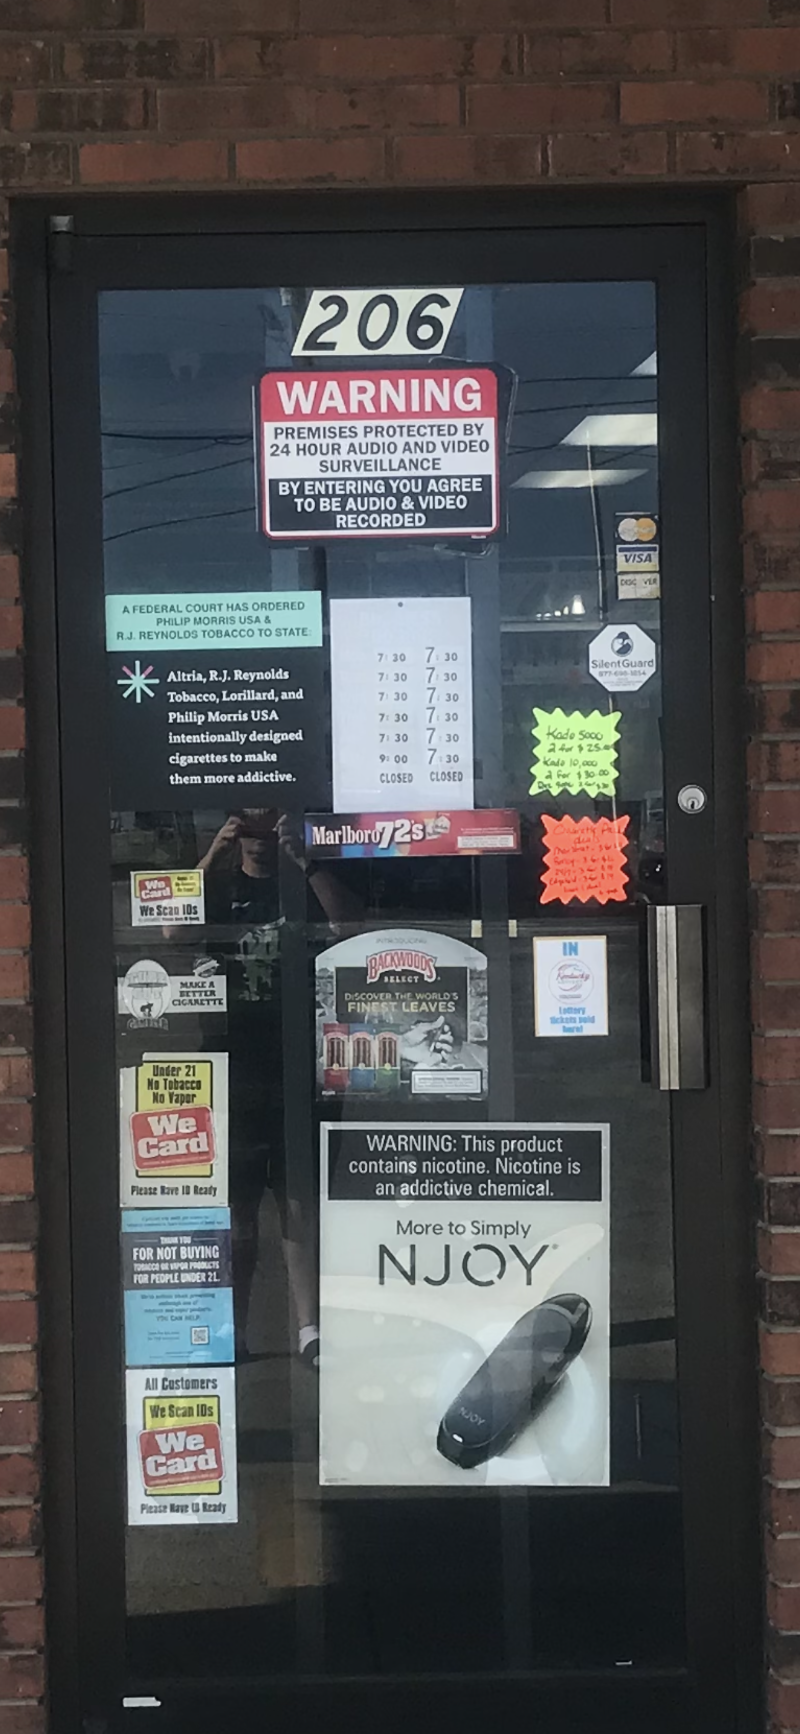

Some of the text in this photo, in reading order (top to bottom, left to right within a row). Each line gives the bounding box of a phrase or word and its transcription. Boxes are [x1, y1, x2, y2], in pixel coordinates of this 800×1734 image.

[302, 294, 451, 350] 206
[276, 378, 482, 415] WARNING
[274, 423, 484, 439] PREMISES PROTECTED BY
[270, 439, 489, 456] 24 HOUR AUDIO AND VIDEO
[319, 458, 441, 473] SURVEILLANCE
[278, 478, 482, 495] BY ENTERING YOU AGREE
[294, 495, 467, 512] TO BE AUDIO & VIDEO
[336, 513, 426, 528] RECORDED
[624, 553, 653, 564] VISA
[620, 578, 658, 587] DISCVER
[122, 601, 305, 614] A FEDERAL COURT HAS ORDERED
[156, 615, 271, 626] PHILIP MORRIS USA &
[116, 627, 312, 641] R.J. REYNOLDS TOBACCO TO STATE:
[167, 669, 289, 683] Altria, R.J. Reynolds
[167, 688, 303, 704] Tobacco, Lorillard, and
[168, 710, 279, 725] Philip Morris USA
[168, 730, 303, 744] intentionally designed
[578, 729, 603, 740] 5000
[547, 742, 556, 753] 2
[558, 743, 574, 753] for
[169, 751, 277, 767] cigarettes to make
[569, 759, 598, 769] 10,000
[169, 771, 297, 784] them more addictive.
[379, 771, 463, 784] CLOSED CLOSED
[544, 770, 553, 780] 2
[556, 769, 571, 779] for
[312, 825, 381, 845] Marlboro
[375, 818, 426, 848] 72's
[144, 880, 166, 889] We
[141, 887, 172, 899] Card
[139, 904, 198, 917] We Scan IDs
[562, 941, 578, 956] IN
[367, 951, 437, 983] BACKWOODS
[179, 981, 207, 989] MAKE
[383, 975, 419, 983] SELECT
[179, 990, 216, 998] BETTER
[344, 992, 459, 1001] DISCOVER THE WORLD'S
[171, 998, 224, 1006] CIGARETTE
[347, 1001, 456, 1013] FINEST LEAVES
[559, 1006, 586, 1015] Lottery
[549, 1016, 577, 1024] tickets
[152, 1064, 196, 1077] Under 21
[147, 1078, 202, 1090] No Tobacco
[152, 1091, 197, 1106] No Vapor
[147, 1114, 198, 1137] We
[137, 1131, 210, 1159] Card
[366, 1134, 563, 1156] WARNING: This product
[348, 1156, 581, 1175] contains nicotine. Nicotine is
[131, 1184, 217, 1197] Please Have ID Ready
[375, 1179, 554, 1196] an addictive chemical.
[396, 1220, 532, 1239] More to Simply
[179, 1236, 192, 1244] YOU
[132, 1245, 220, 1261] FOR NOT BUYING
[133, 1261, 220, 1271] TOBACCO OR VAPOR PRODUCTS
[378, 1243, 550, 1287] NJOY
[133, 1271, 221, 1284] FOR PEOPLE UNDER 21.
[144, 1377, 218, 1391] All Customers
[149, 1404, 214, 1418] We Scan IDs
[155, 1431, 205, 1454] We
[145, 1448, 218, 1477] Card
[140, 1504, 168, 1514] Please
[169, 1503, 189, 1514] Have
[202, 1502, 227, 1514] Ready
